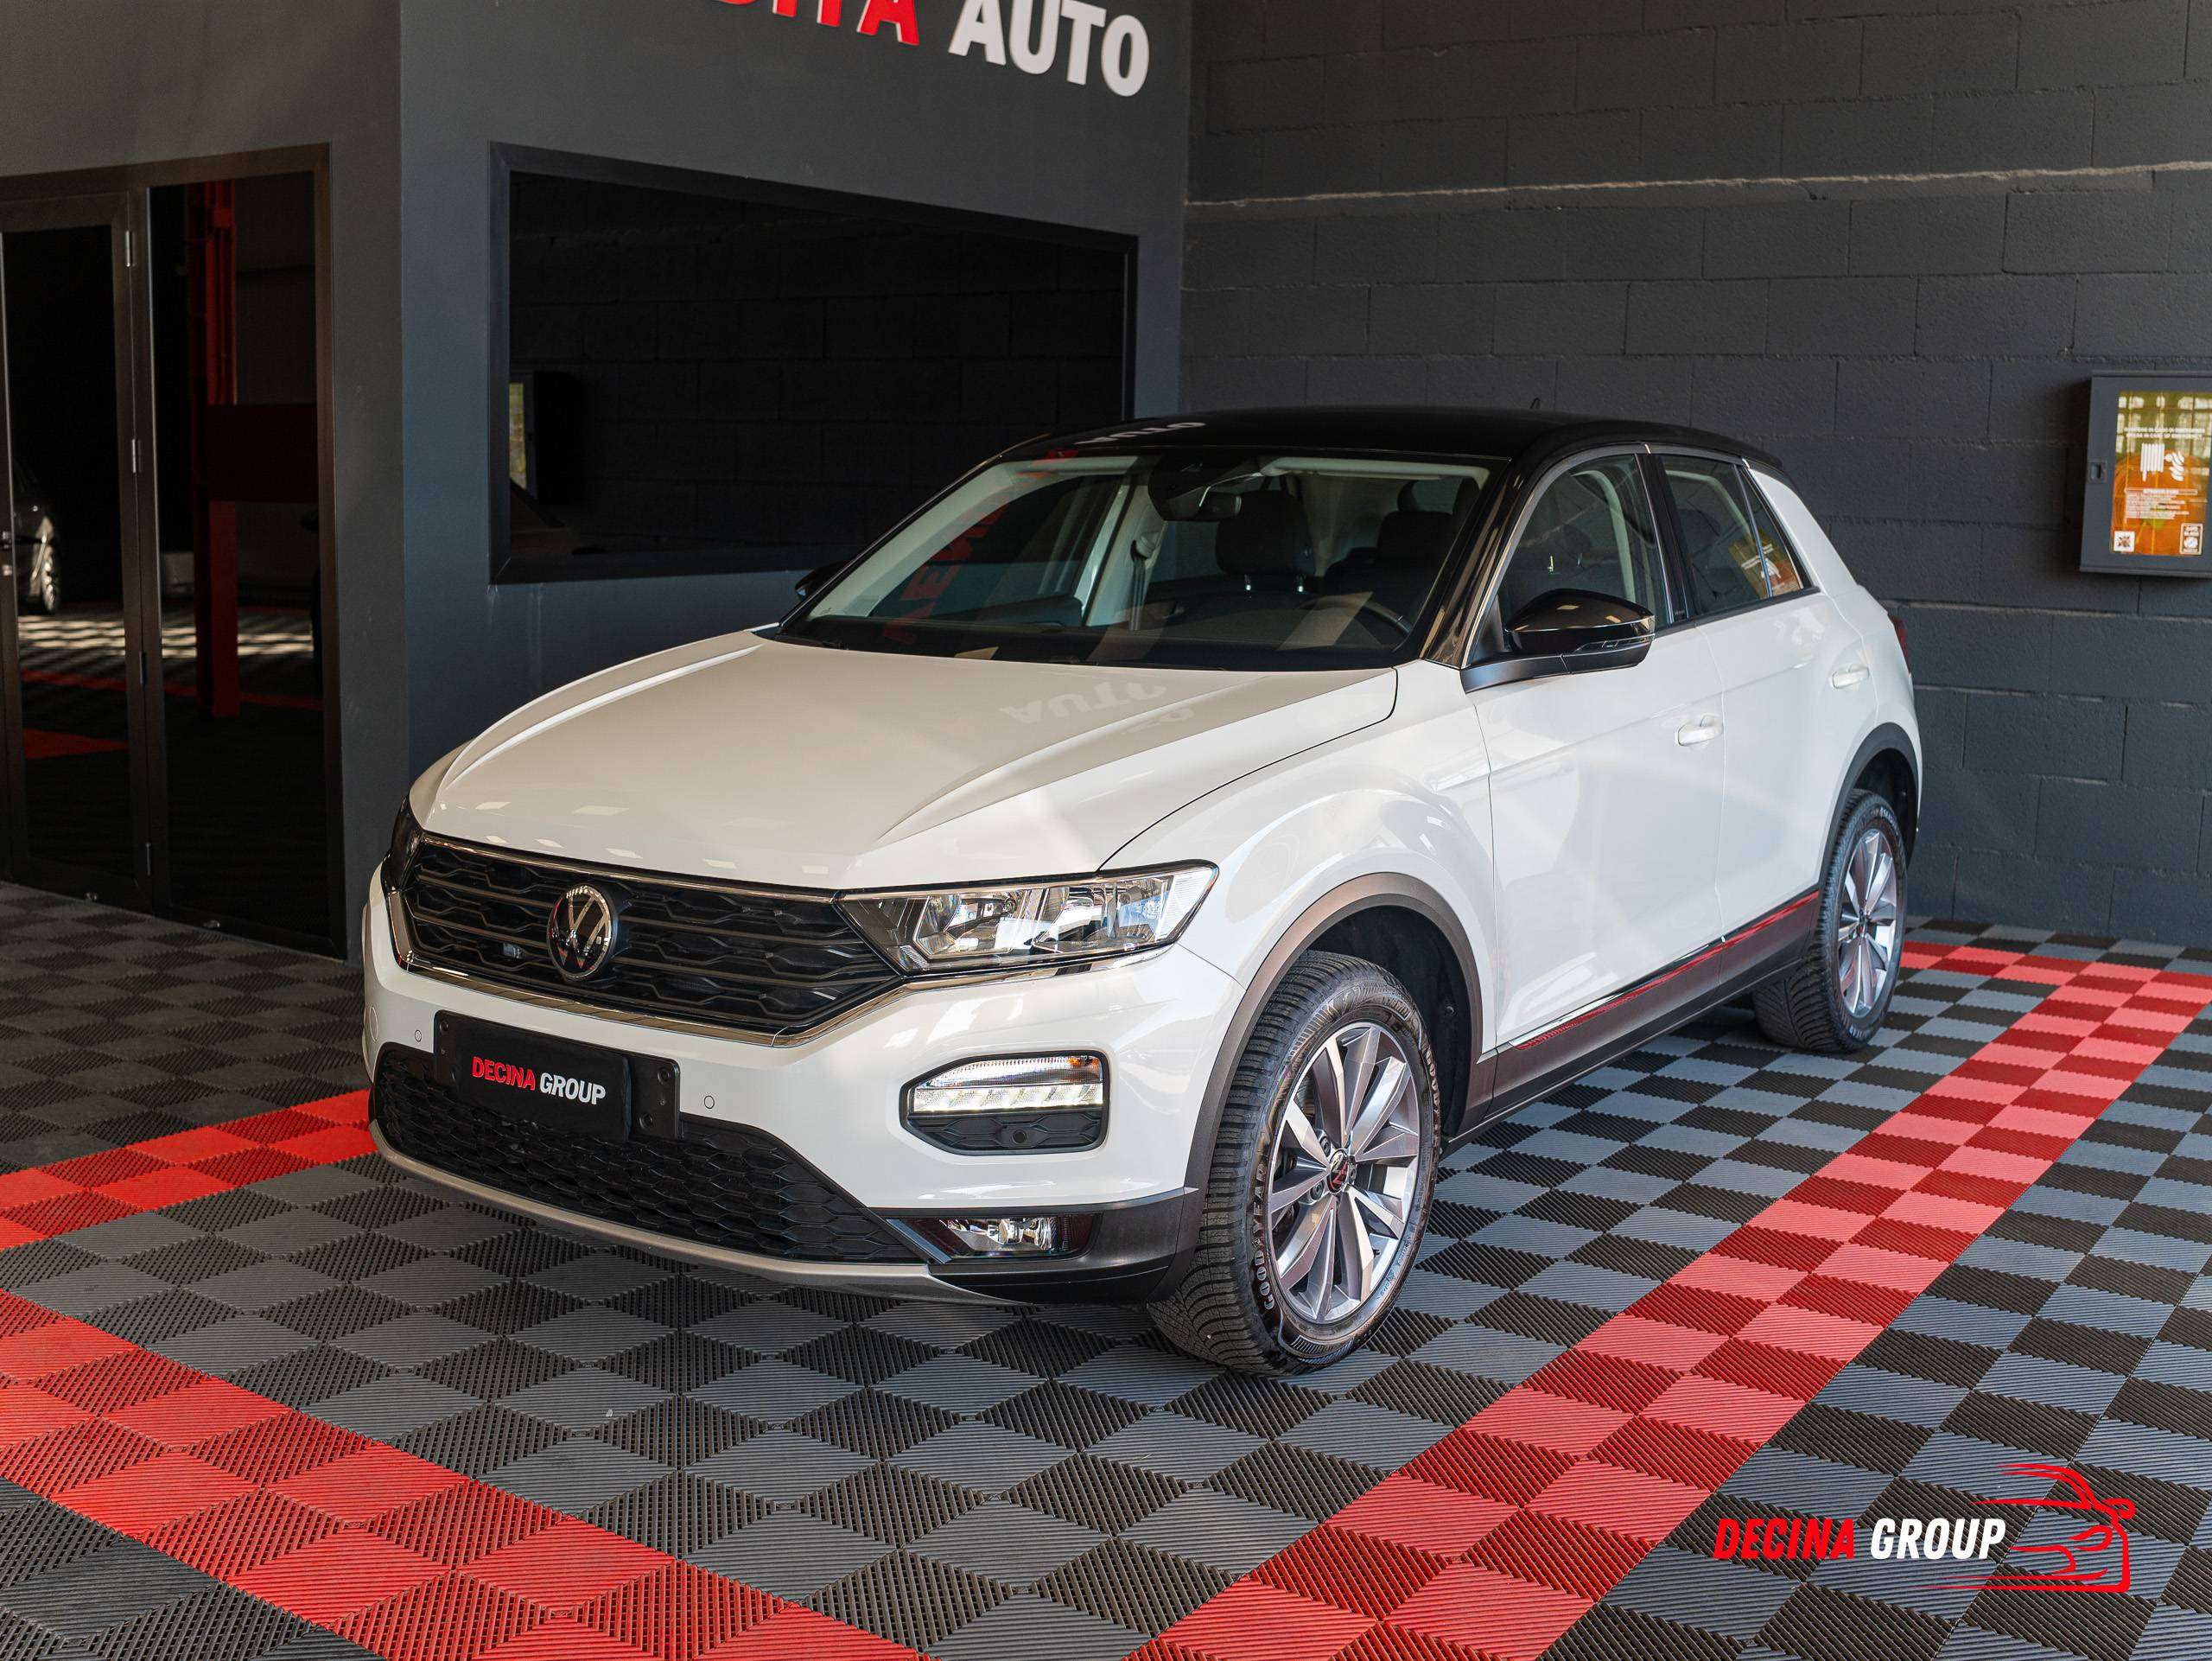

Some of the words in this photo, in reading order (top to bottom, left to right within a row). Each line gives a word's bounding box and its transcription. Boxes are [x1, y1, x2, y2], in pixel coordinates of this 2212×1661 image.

[949, 0, 1149, 97] AUTO
[472, 1056, 536, 1091] DECINA
[539, 1072, 607, 1105] GROUP
